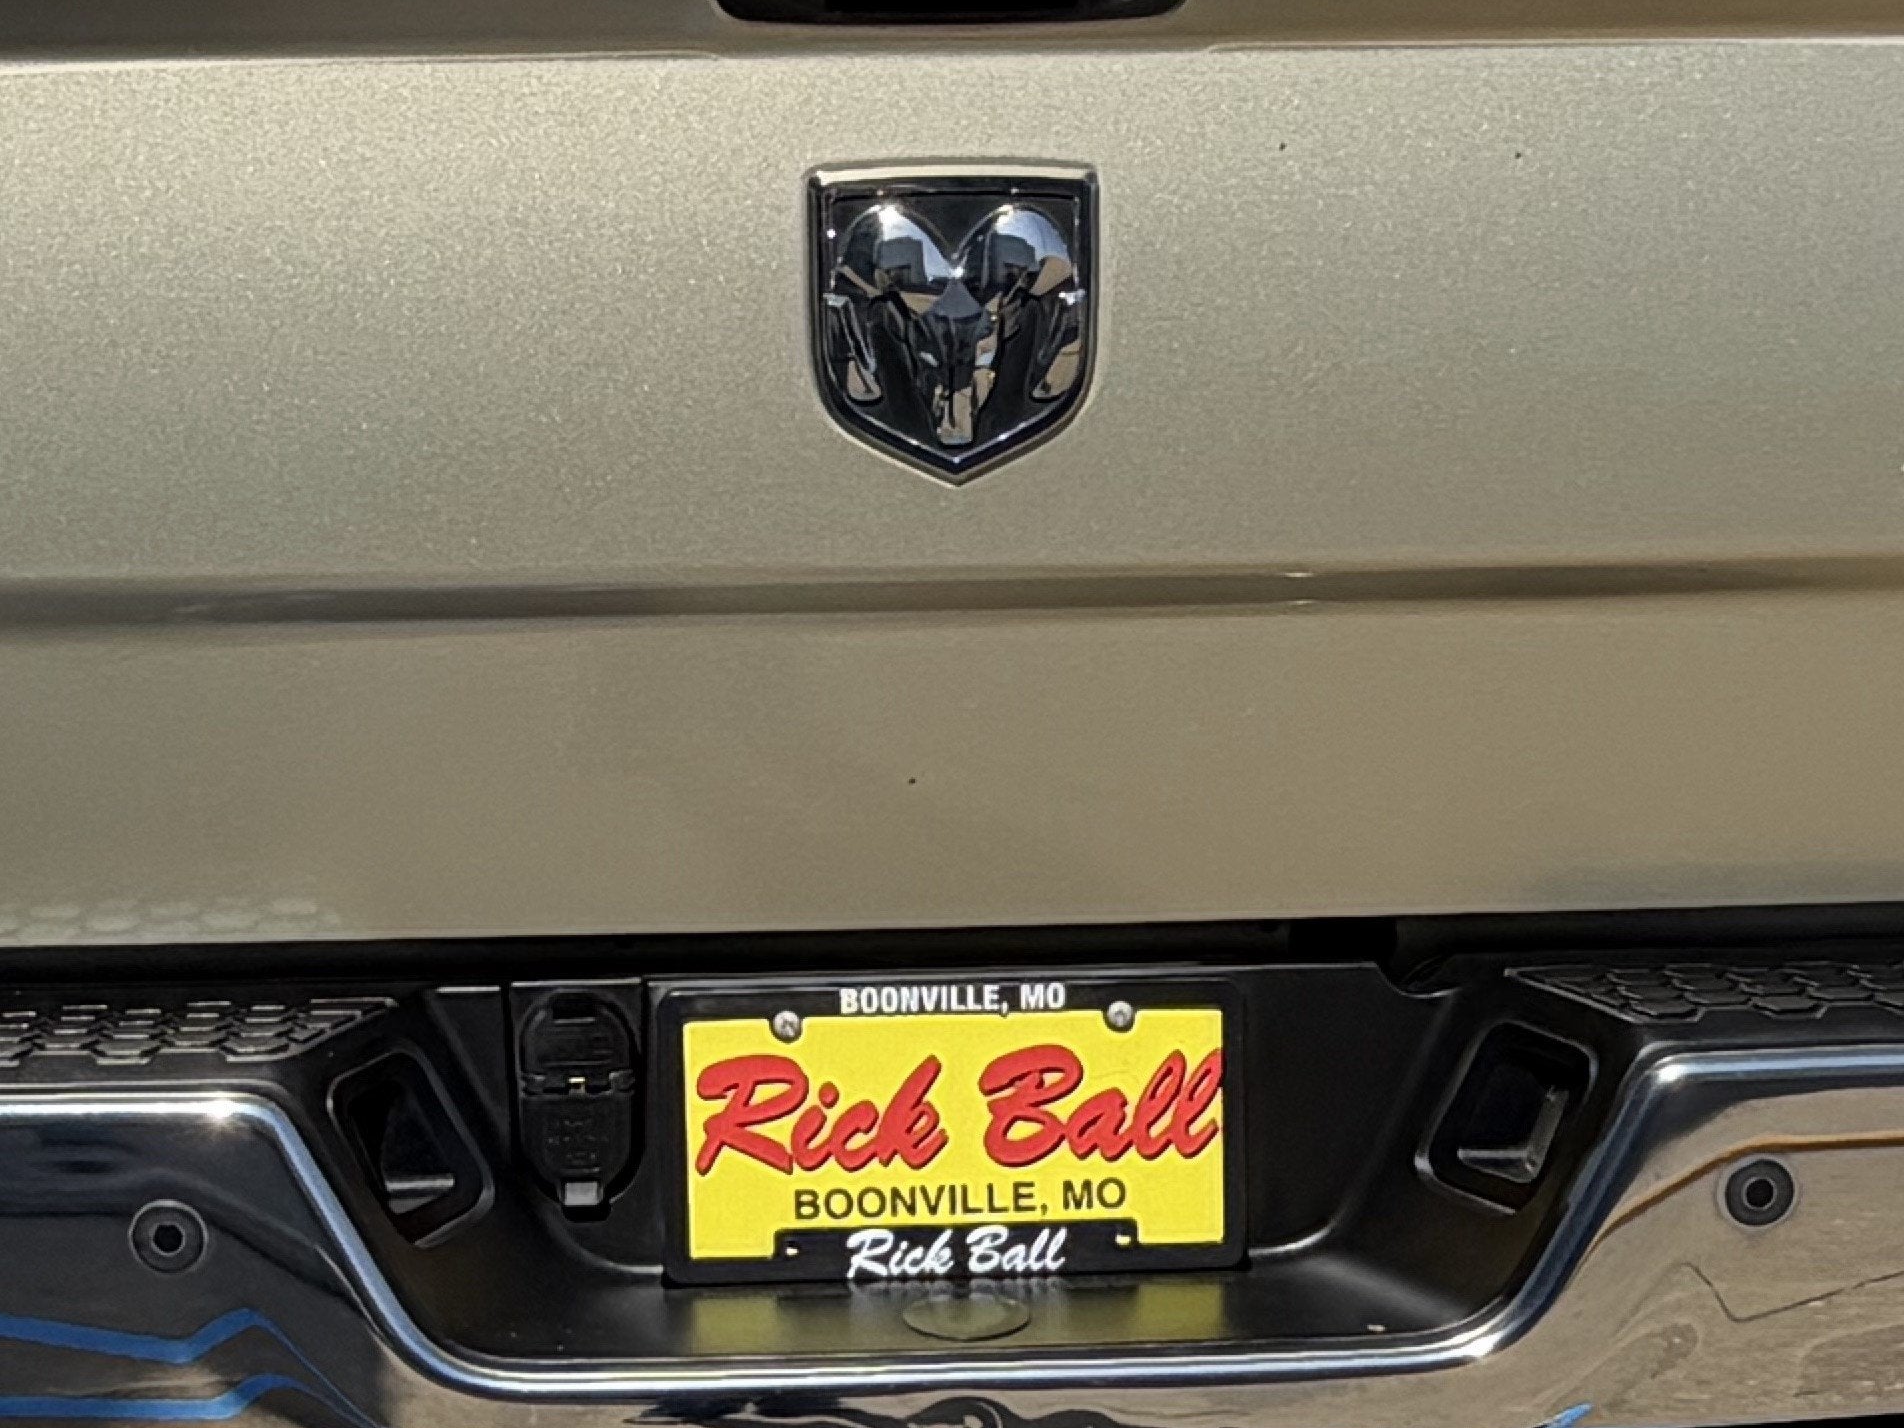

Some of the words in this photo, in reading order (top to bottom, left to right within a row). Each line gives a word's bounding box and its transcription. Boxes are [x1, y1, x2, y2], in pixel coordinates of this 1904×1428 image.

[839, 984, 1010, 1017] BOONVILLE,
[1019, 982, 1067, 1010] MO
[696, 1053, 949, 1175] Rick
[978, 1043, 1226, 1169] Ball
[794, 1179, 1049, 1221] BOONVILLE,
[1061, 1177, 1128, 1212] MO
[846, 1227, 955, 1280] Rick
[966, 1224, 1068, 1274] Ball
